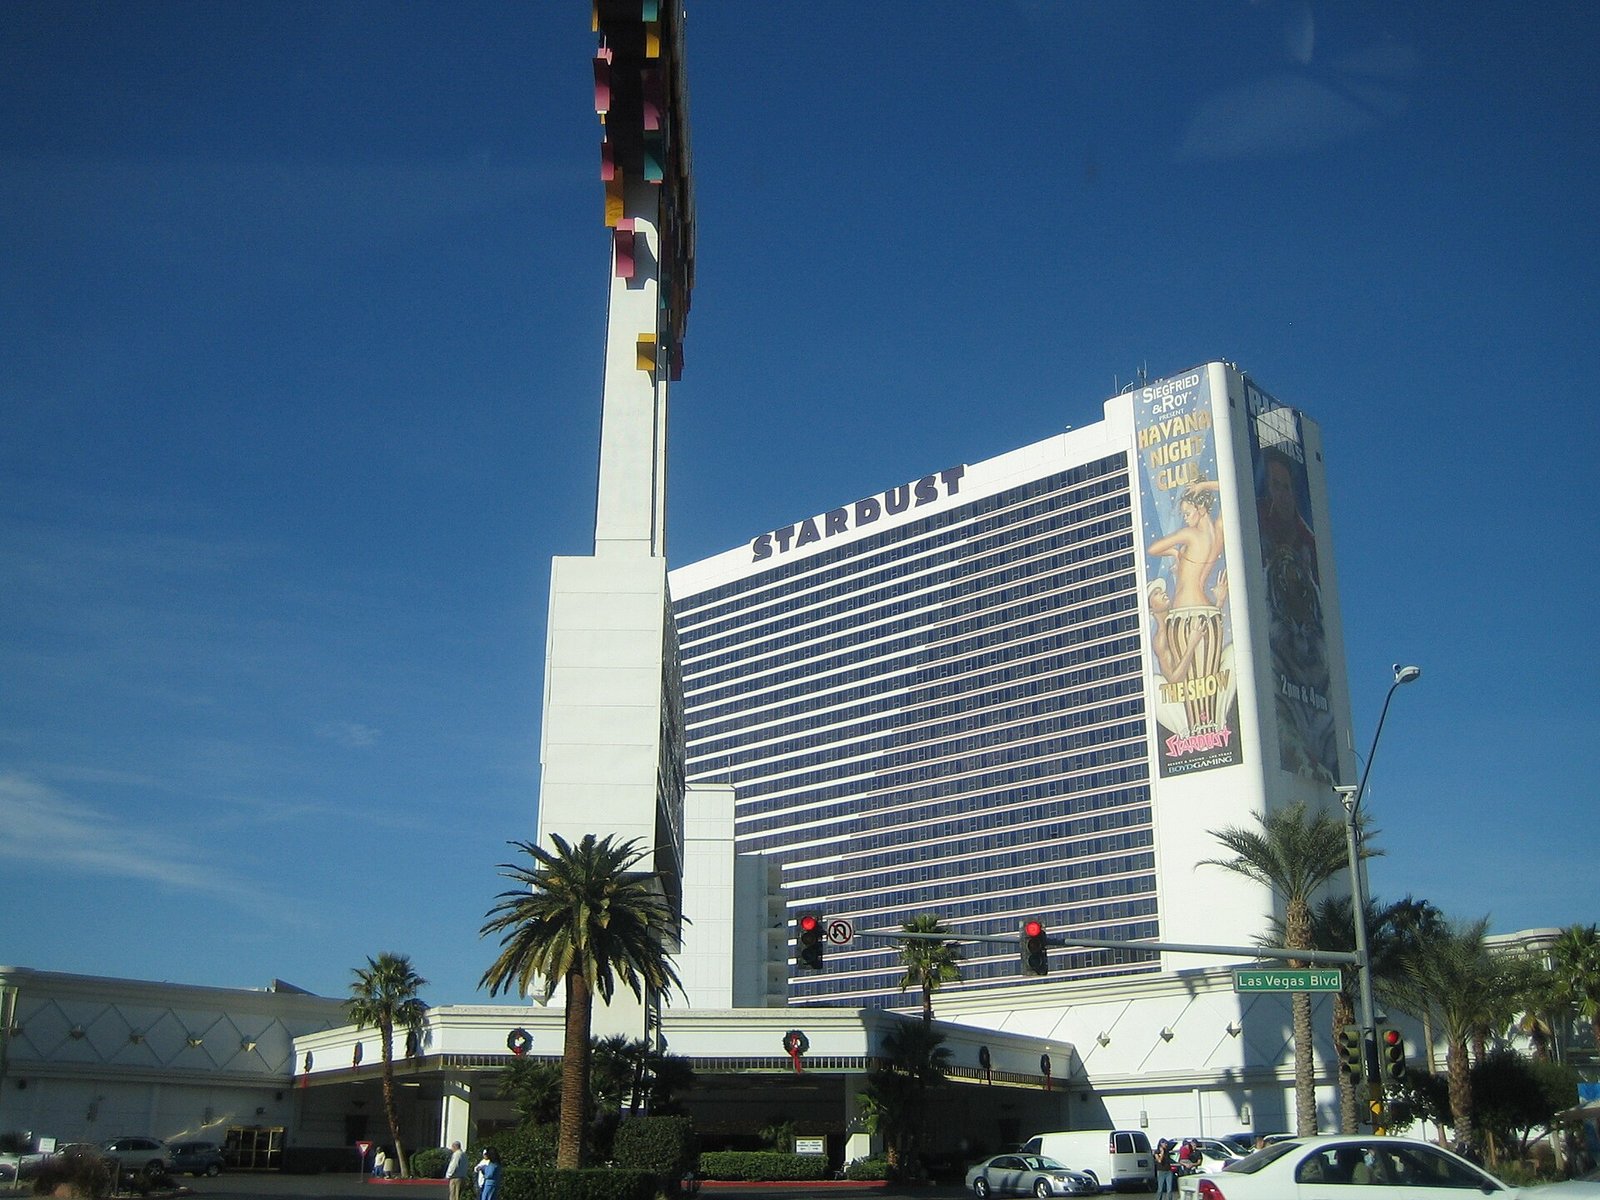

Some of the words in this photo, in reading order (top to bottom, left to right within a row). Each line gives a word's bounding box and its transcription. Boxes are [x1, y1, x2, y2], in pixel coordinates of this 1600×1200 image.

[1142, 374, 1199, 403] SIEGFRIED
[1152, 405, 1162, 415] &
[1162, 392, 1188, 413] ROY
[1138, 409, 1212, 449] HAVANA
[1159, 408, 1184, 421] PRESENT
[1151, 435, 1202, 469] NIGHT
[1157, 460, 1200, 491] CLUB
[752, 464, 964, 563] STARDUST
[1159, 682, 1185, 704] THE
[1188, 669, 1230, 701] SHOW
[1301, 685, 1308, 703] &
[1165, 725, 1232, 757] STARDUST
[1239, 975, 1262, 986] Las
[1265, 975, 1305, 989] Vegas
[1310, 975, 1338, 986] Blvd
